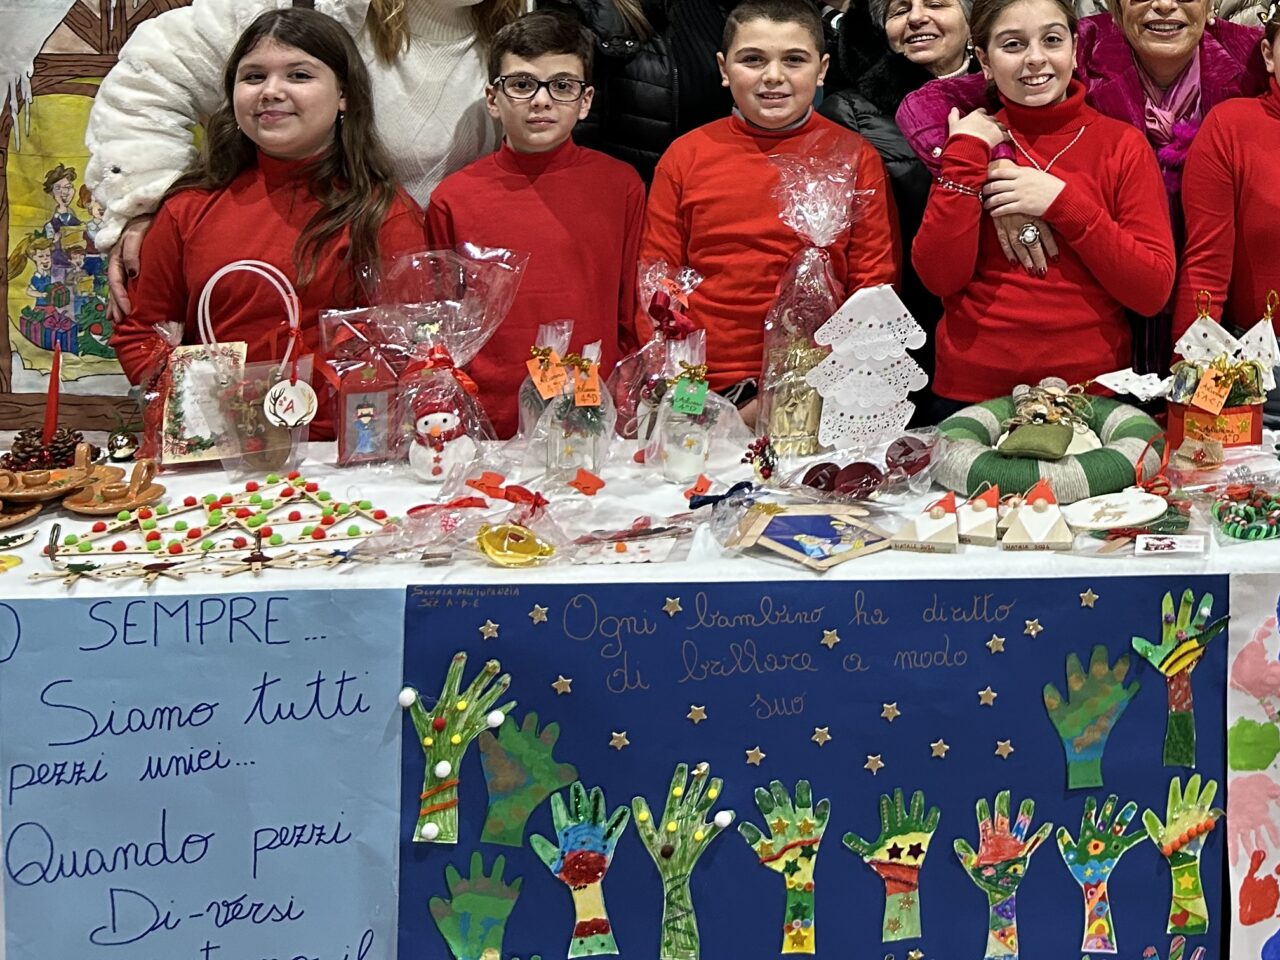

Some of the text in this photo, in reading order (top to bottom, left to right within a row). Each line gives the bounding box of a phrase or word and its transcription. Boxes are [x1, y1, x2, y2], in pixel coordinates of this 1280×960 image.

[563, 593, 657, 658] Ogni
[686, 591, 825, 630] bambino
[849, 590, 889, 626] ha
[606, 633, 968, 693] di brillare a modo
[40, 670, 371, 747] Siamo tutti
[9, 742, 256, 805] pezzi unici...
[5, 808, 352, 886] Quando pezzi
[89, 887, 305, 946] Di-versi
